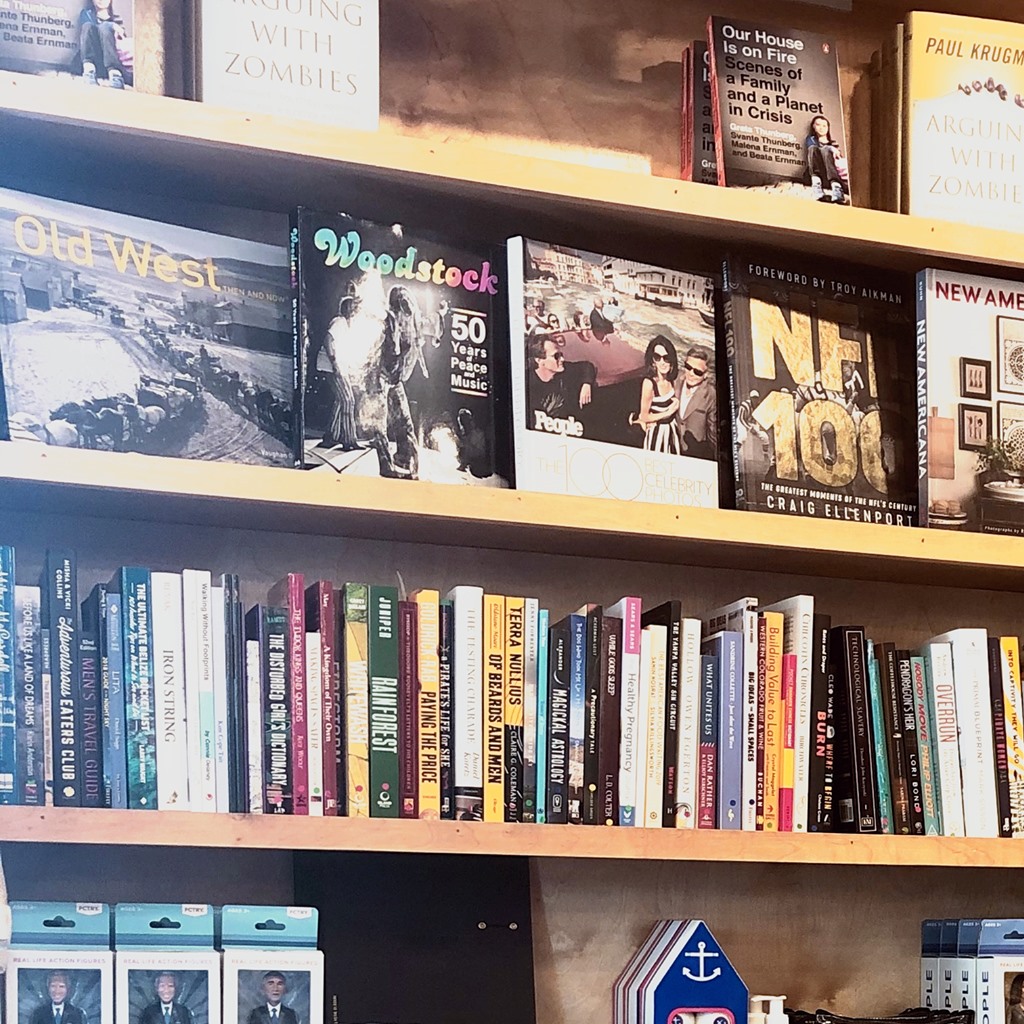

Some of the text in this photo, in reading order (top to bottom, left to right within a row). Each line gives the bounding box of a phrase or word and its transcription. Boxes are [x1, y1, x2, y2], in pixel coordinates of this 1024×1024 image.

[723, 25, 804, 52] Our House
[925, 37, 964, 60] PAUL
[724, 40, 798, 65] Is on Fire
[725, 56, 803, 82] Scenes of
[727, 74, 791, 98] a Family
[728, 88, 824, 115] and a Planet
[728, 102, 793, 126] in Crisis
[951, 147, 1016, 172] WITH
[15, 215, 223, 292] Old West
[313, 227, 499, 296] Woodstock
[749, 264, 902, 304] FOREWORD BY TROY AIKMAN
[935, 279, 983, 306] NEW
[450, 314, 487, 342] 50
[451, 342, 488, 360] Years
[451, 358, 488, 375] Peace
[450, 376, 488, 392] Music
[534, 410, 584, 437] People
[767, 495, 913, 527] CRAIG ELLENPORT
[378, 597, 392, 639] JUNIPER
[163, 649, 176, 743] IRON STRING
[371, 676, 398, 753] RAINFOREST
[936, 684, 956, 743] OVERRUN
[816, 710, 827, 757] BURN
